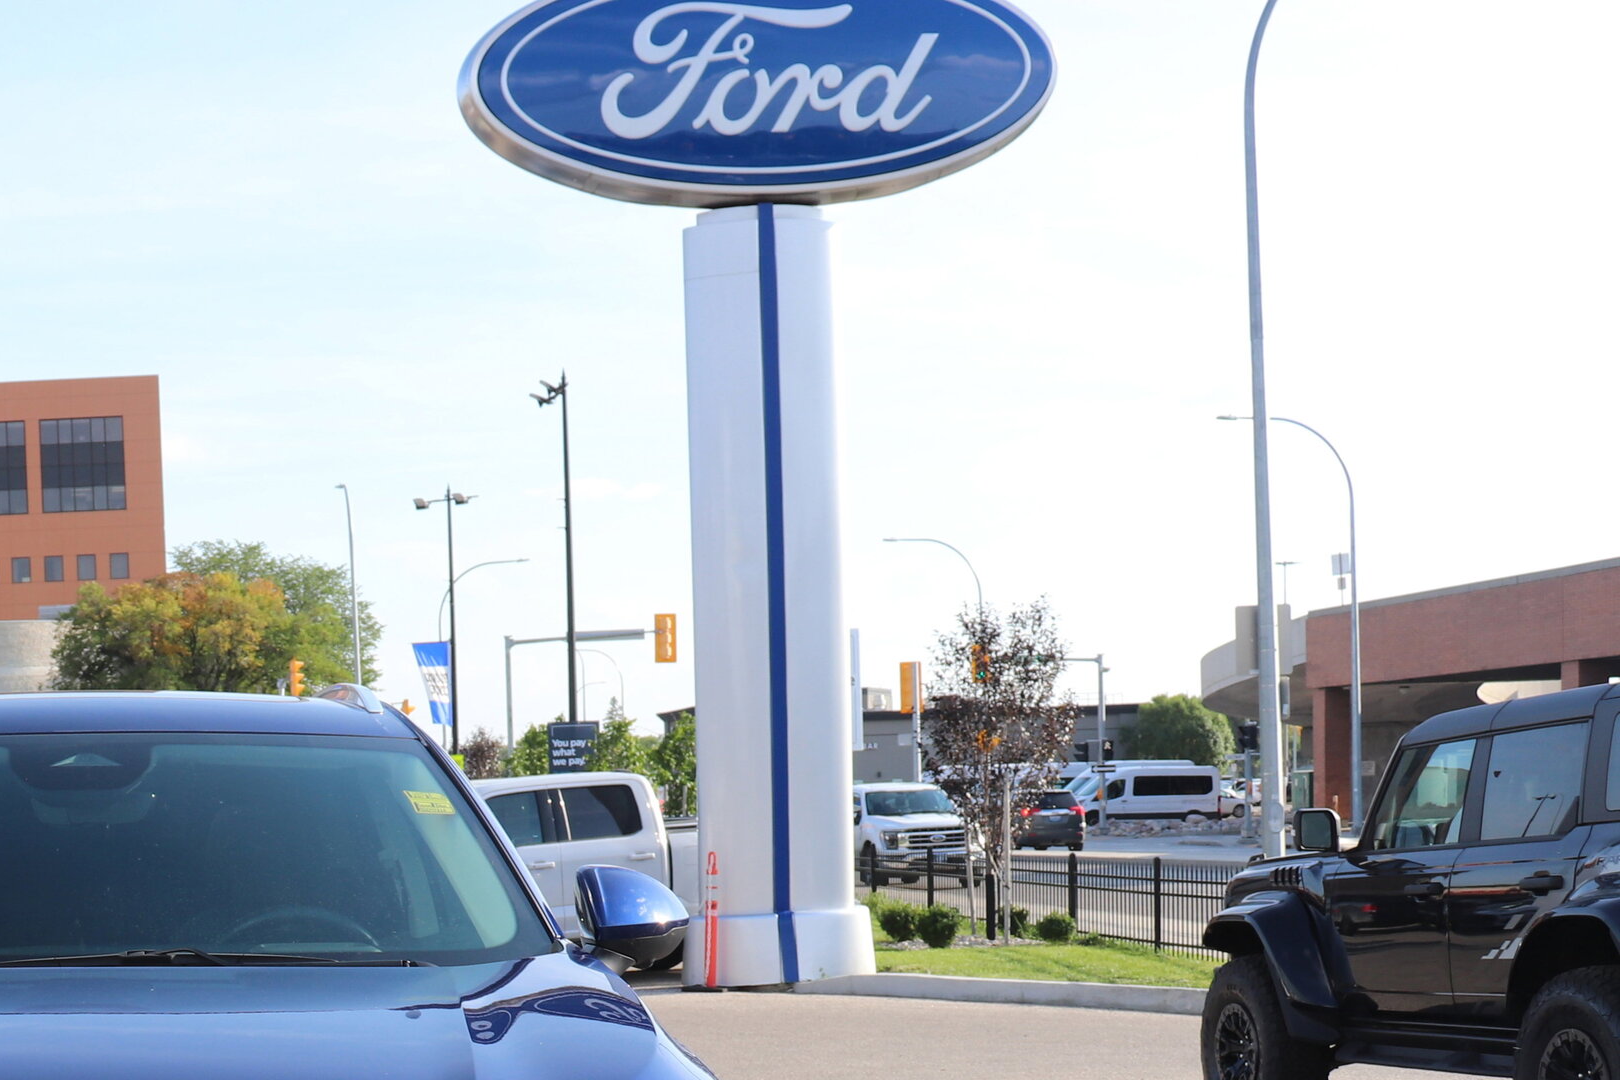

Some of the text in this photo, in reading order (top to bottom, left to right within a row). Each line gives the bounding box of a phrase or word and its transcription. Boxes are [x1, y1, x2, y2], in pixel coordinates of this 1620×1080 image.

[601, 3, 940, 140] Ford
[552, 739, 587, 748] You pay
[552, 748, 577, 757] what
[552, 758, 567, 766] we
